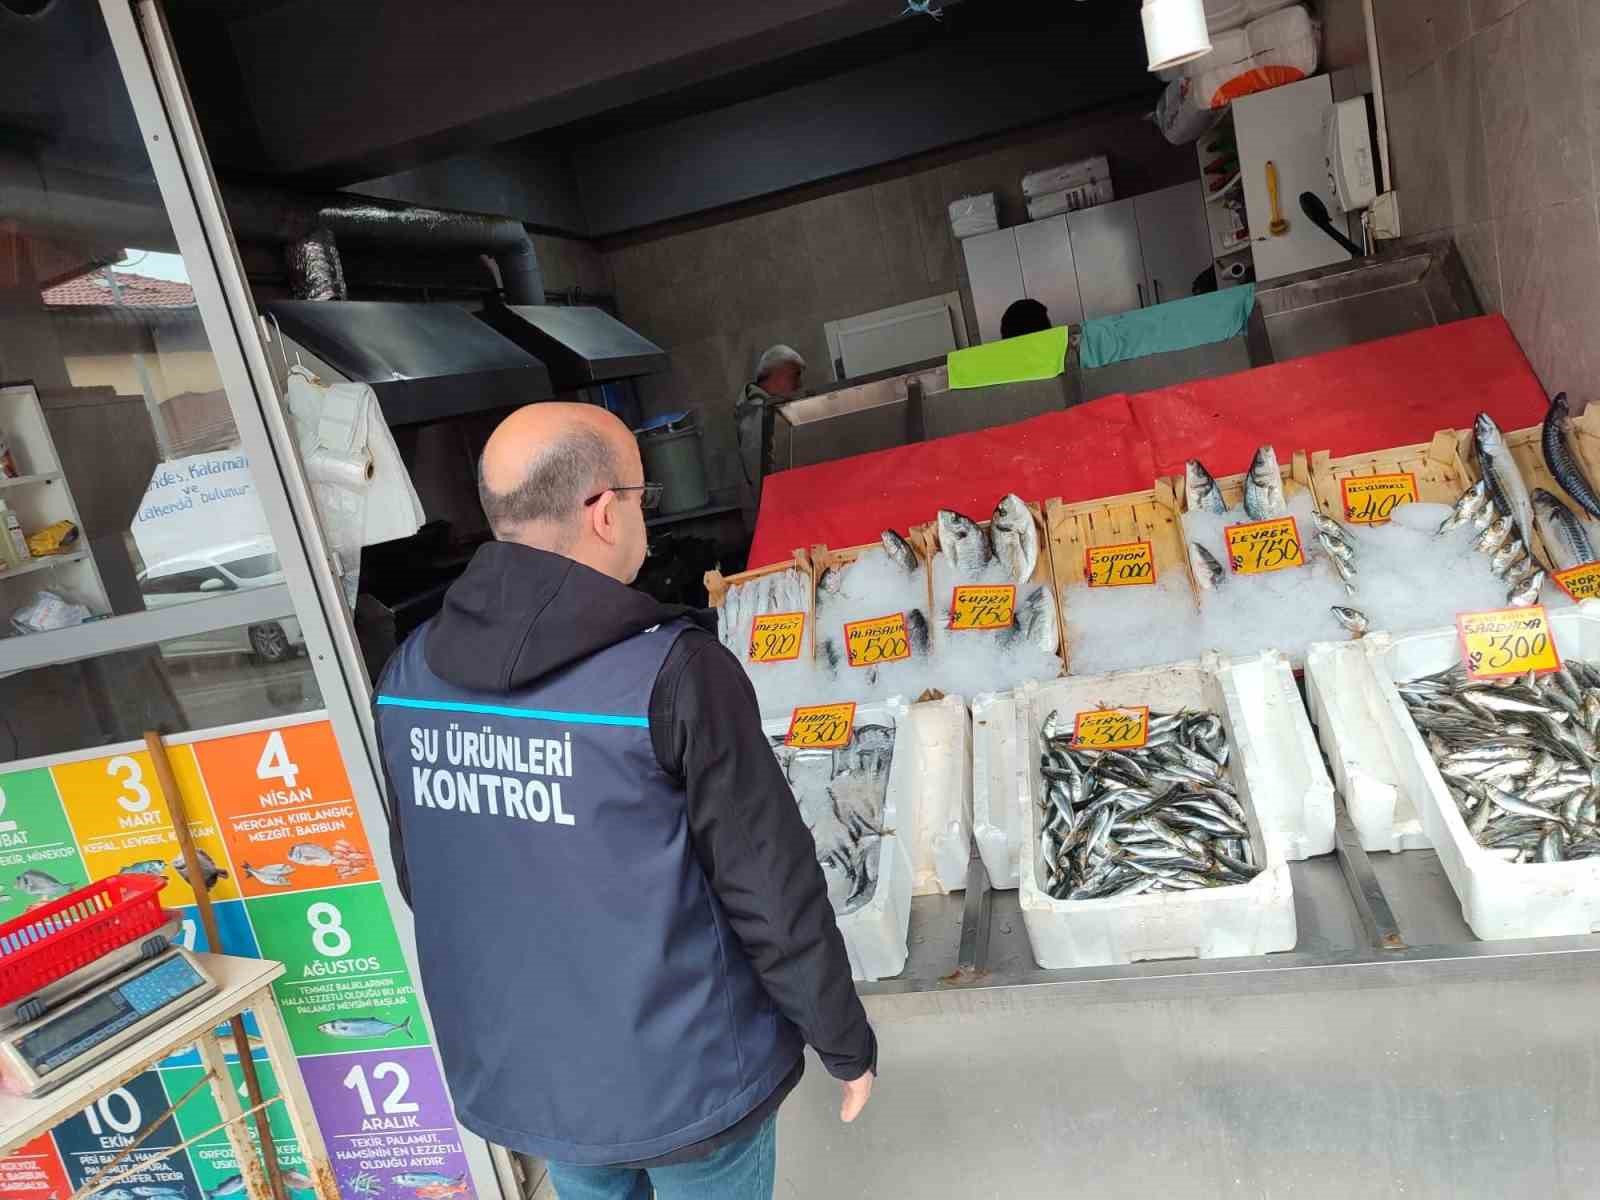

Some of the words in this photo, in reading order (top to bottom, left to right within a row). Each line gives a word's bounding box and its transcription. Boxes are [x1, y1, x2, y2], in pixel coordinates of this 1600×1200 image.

[1249, 538, 1299, 569] 750
[1565, 574, 1600, 588] NOR
[760, 633, 796, 659] 900
[863, 637, 908, 664] 500
[1488, 633, 1547, 669] 300
[801, 720, 849, 744] 300
[1090, 722, 1142, 745] 300
[256, 731, 299, 788] 4
[409, 727, 439, 764] SU
[446, 723, 573, 777] ÜRÜNLERİ
[106, 756, 151, 813] 3
[259, 787, 312, 808] NİSAN
[411, 766, 576, 826] KONTROL
[118, 810, 162, 830] MART
[0, 831, 28, 849] BAT
[306, 902, 352, 957] 8
[303, 957, 380, 978] AĞUSTOS
[343, 1061, 420, 1115] 12
[83, 1087, 142, 1135] 10
[361, 1115, 420, 1131] ARALIK
[360, 1156, 408, 1170] OLDUĞU
[393, 1147, 409, 1157] EN
